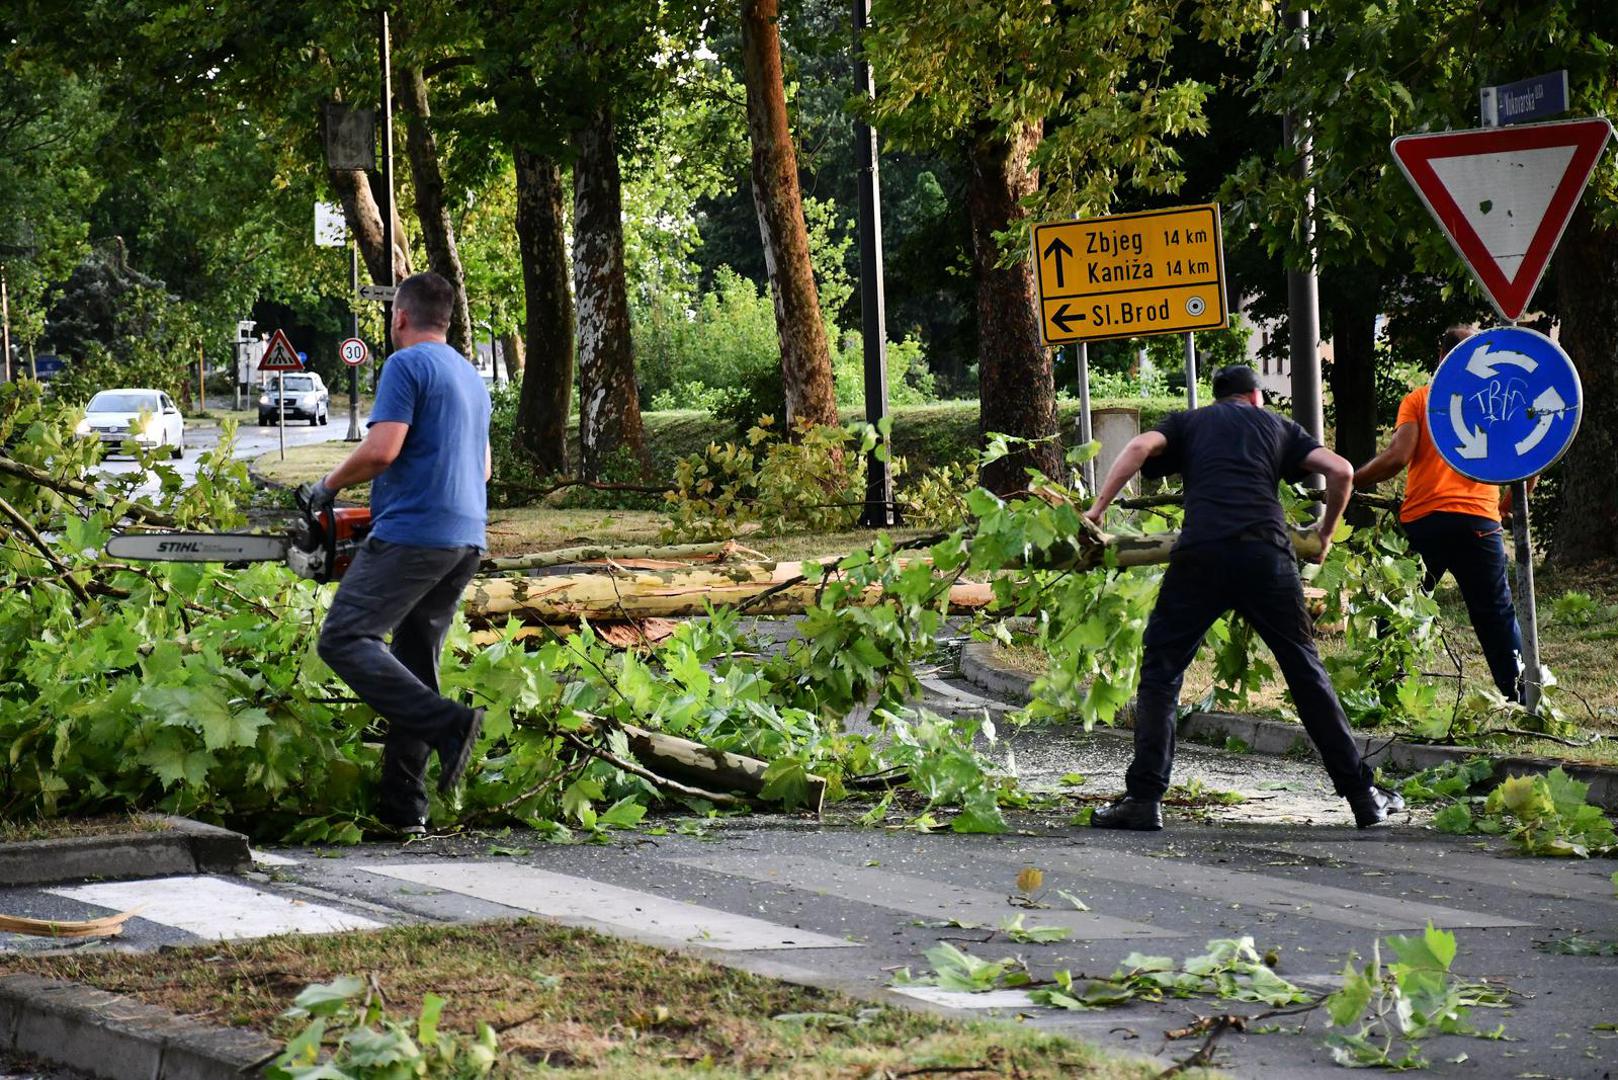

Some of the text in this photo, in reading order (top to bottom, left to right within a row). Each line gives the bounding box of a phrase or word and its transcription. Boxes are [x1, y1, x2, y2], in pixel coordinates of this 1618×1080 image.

[1086, 229, 1207, 257] Zbjeg 14 km
[1088, 259, 1209, 284] Kaniža 14 km
[346, 346, 361, 359] 30
[157, 541, 200, 553] STIHL
